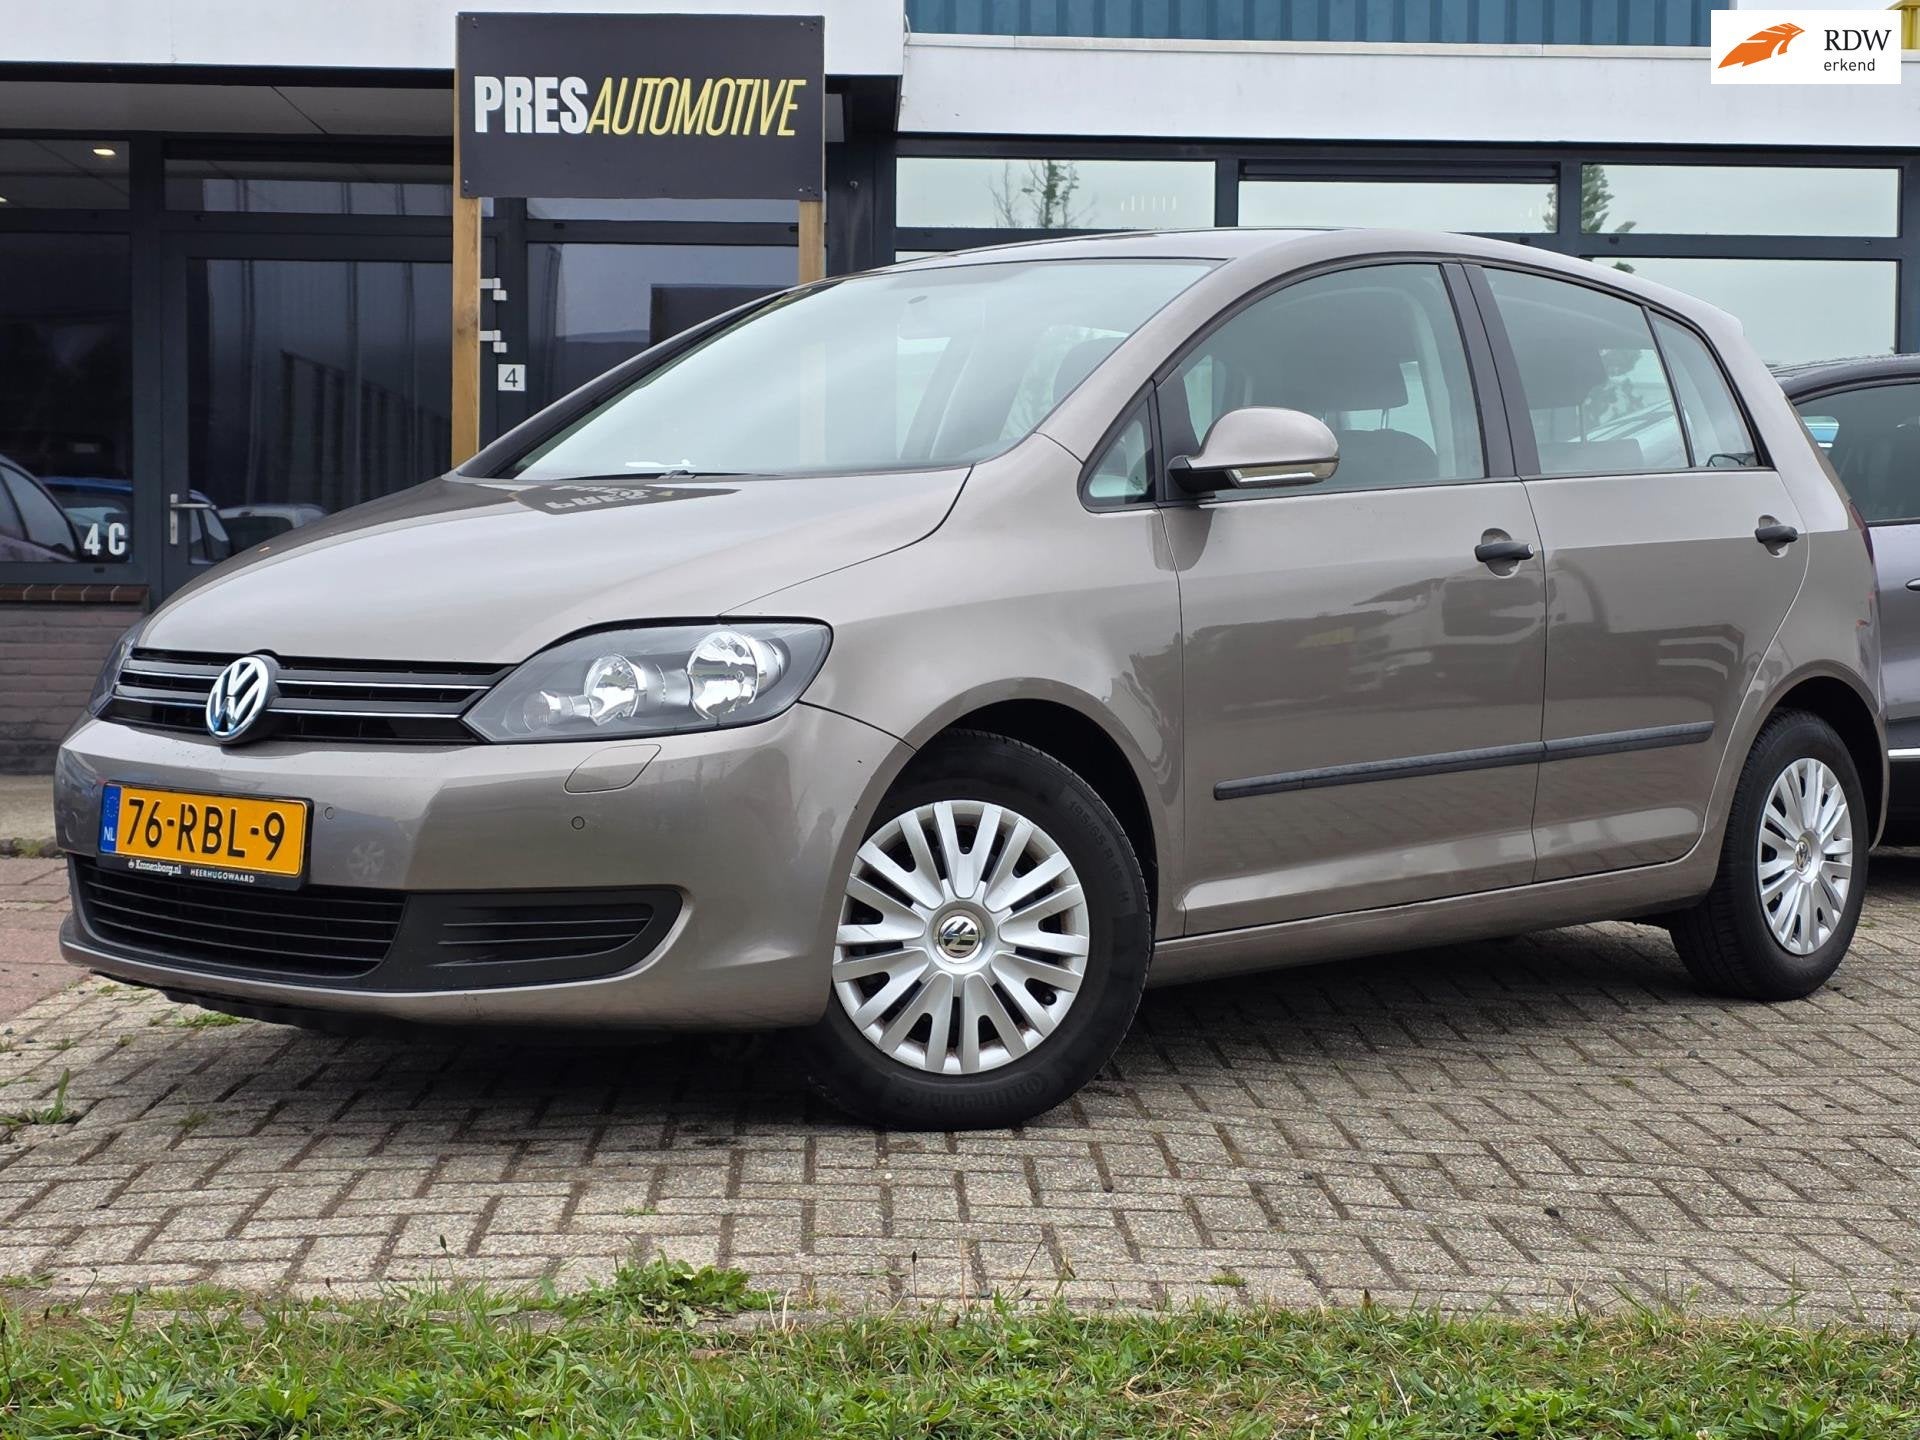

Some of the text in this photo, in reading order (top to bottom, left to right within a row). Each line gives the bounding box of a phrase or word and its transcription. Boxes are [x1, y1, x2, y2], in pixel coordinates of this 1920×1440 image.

[504, 367, 518, 388] 4
[84, 522, 126, 555] 4 C
[103, 826, 115, 842] NL
[127, 798, 285, 861] 76-RBL-9
[190, 868, 255, 883] HEERHUGOWAARD
